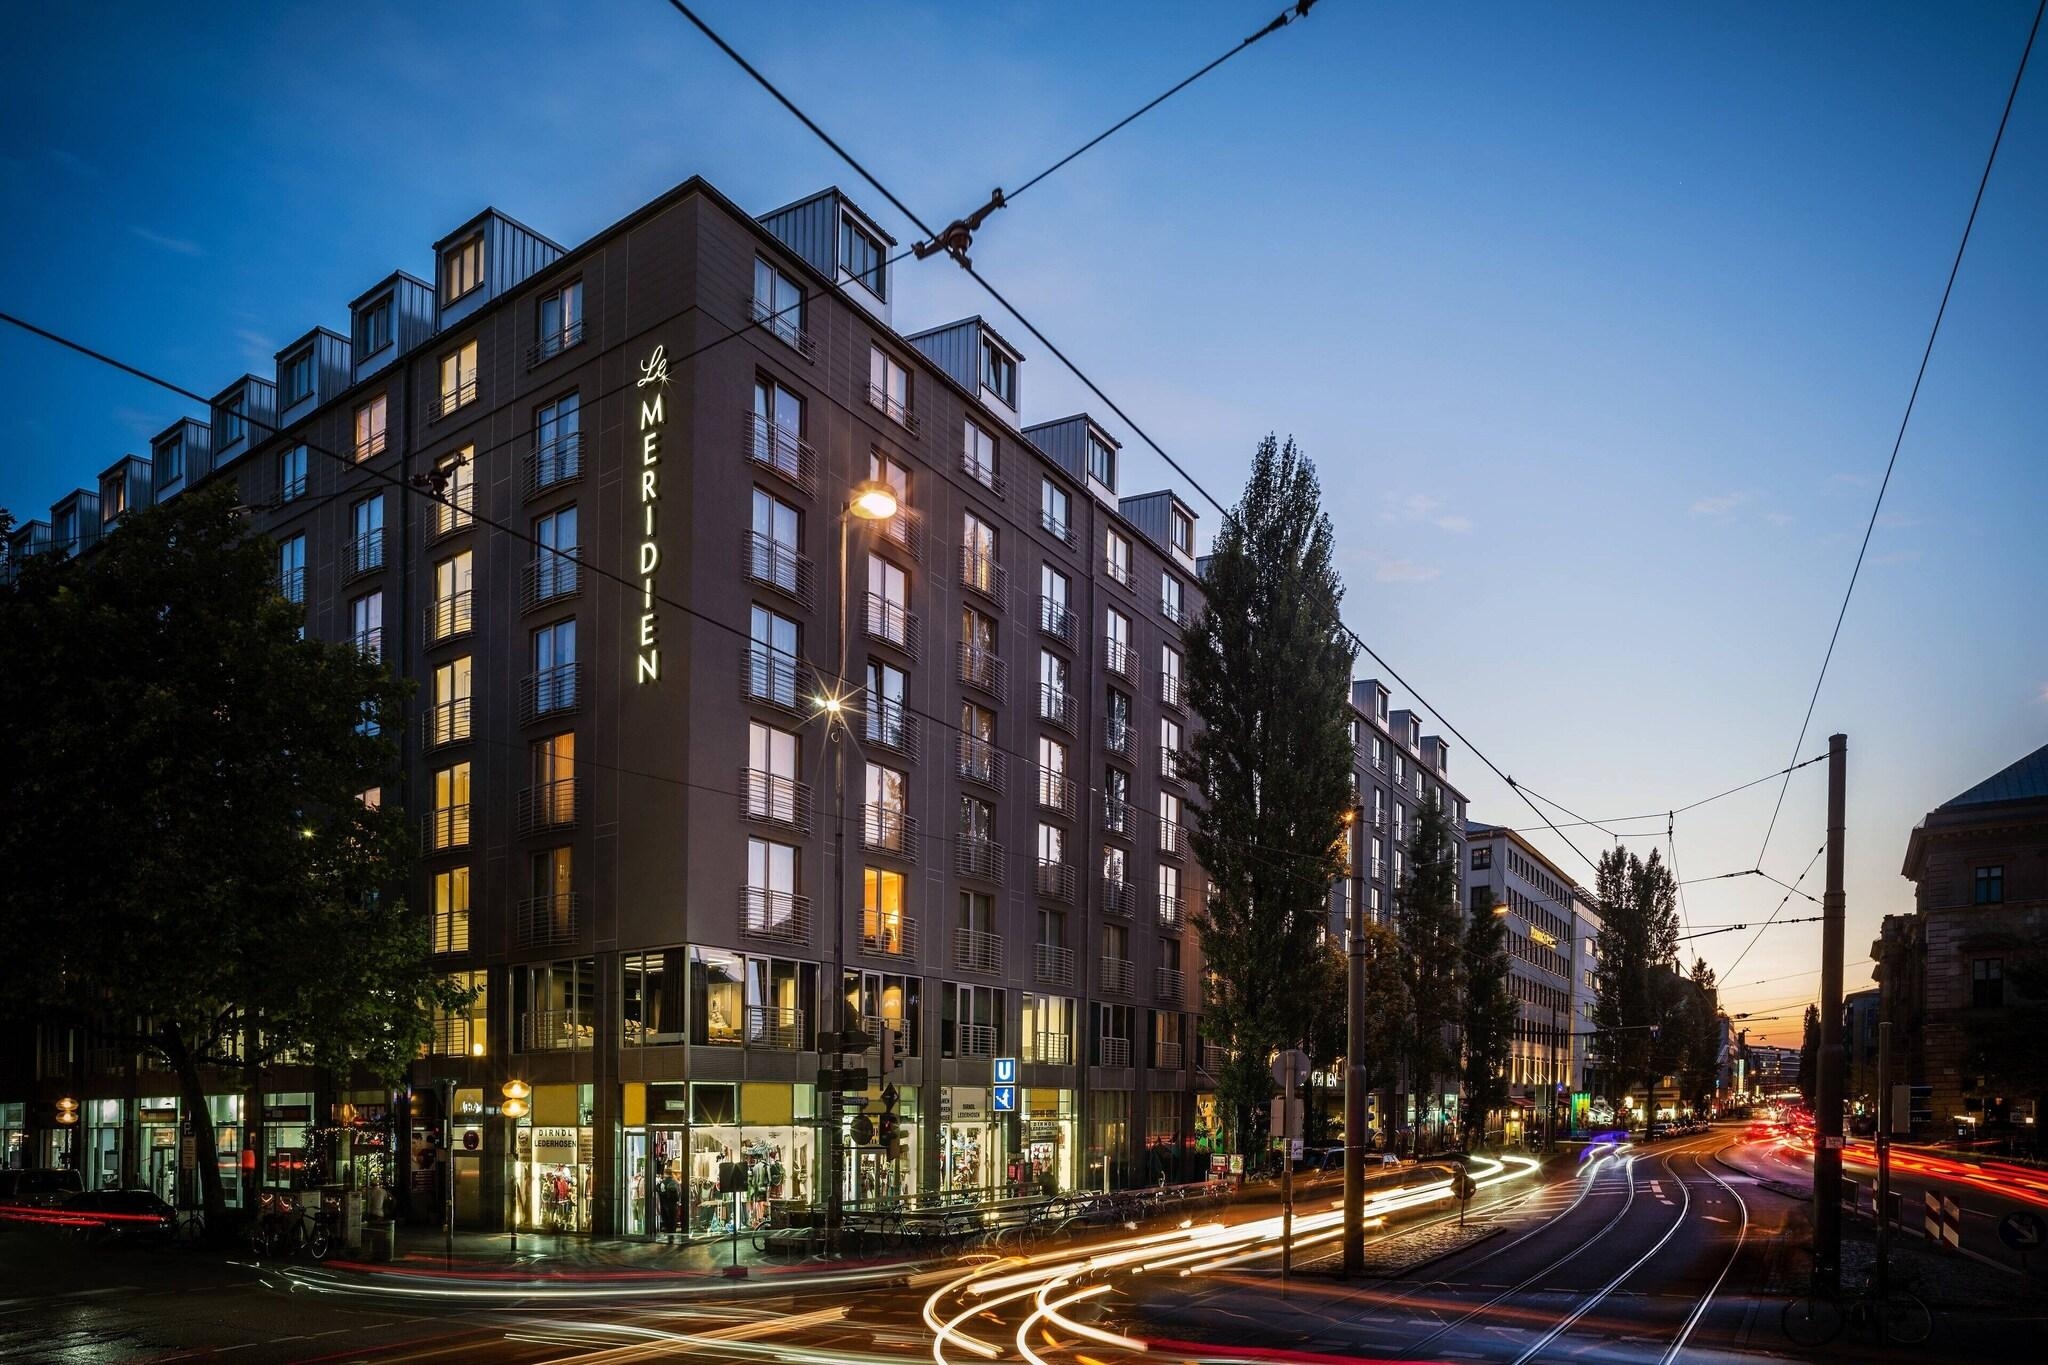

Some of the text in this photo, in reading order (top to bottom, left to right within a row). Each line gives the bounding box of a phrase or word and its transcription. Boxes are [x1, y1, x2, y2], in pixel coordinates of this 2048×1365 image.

[637, 345, 667, 387] Le
[638, 393, 665, 685] MERIDIEN
[998, 1061, 1011, 1080] U
[538, 1129, 572, 1137] DIRNDL
[534, 1140, 577, 1148] LEDERHOSEN
